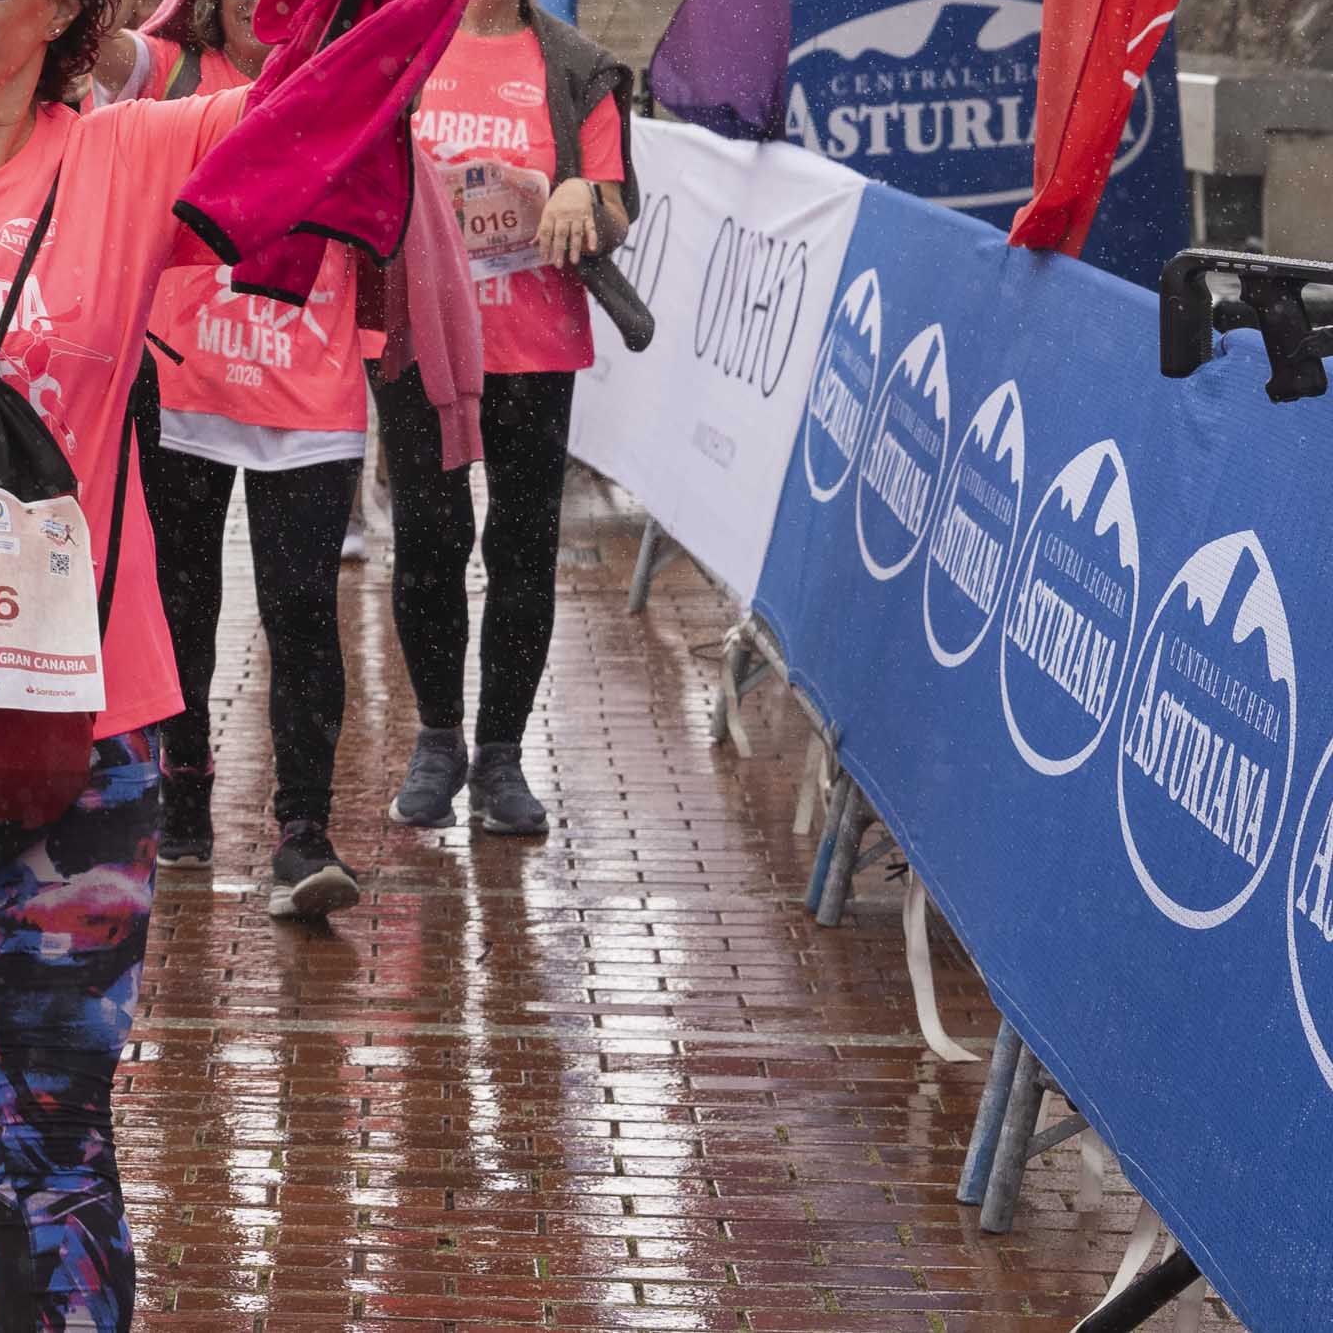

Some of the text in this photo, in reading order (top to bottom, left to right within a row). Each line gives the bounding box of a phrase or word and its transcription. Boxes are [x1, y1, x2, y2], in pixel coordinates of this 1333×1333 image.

[833, 66, 982, 96] CENTRAL
[469, 209, 519, 235] 016
[197, 318, 291, 370] MUJER
[225, 362, 263, 387] 2026
[932, 462, 1004, 616] ASTURIANA
[1043, 532, 1127, 619] CENTRAL LECHERA
[1006, 529, 1117, 724] ASTURIANA
[33, 656, 89, 672] CANARIA
[1168, 636, 1282, 744] CENTRAL LECHERA
[35, 686, 77, 698] Santander
[1124, 631, 1270, 868] ASTURIANA
